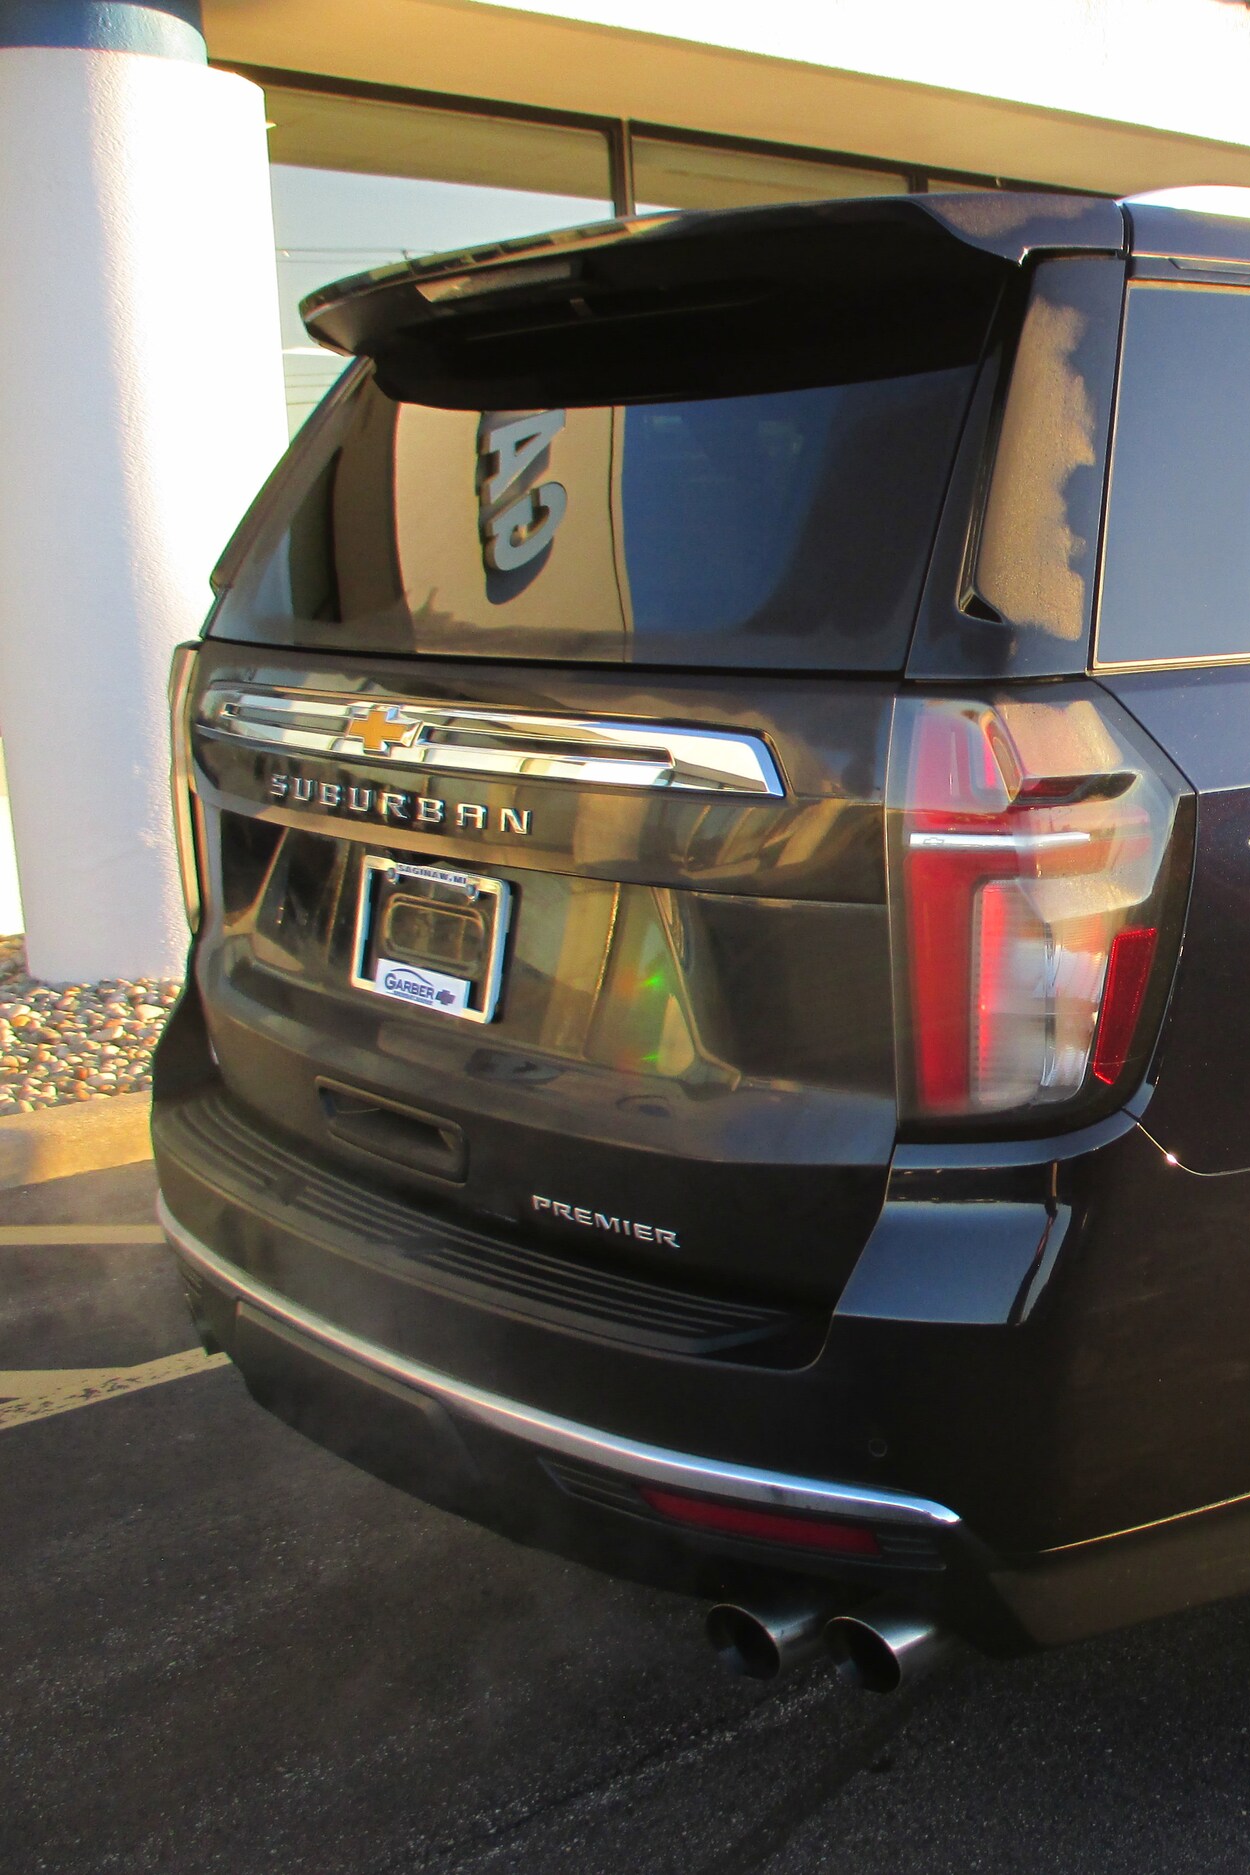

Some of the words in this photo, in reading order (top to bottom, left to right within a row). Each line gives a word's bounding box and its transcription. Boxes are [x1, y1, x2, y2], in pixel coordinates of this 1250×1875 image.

[269, 774, 532, 835] SUBURBAN
[384, 972, 435, 1000] GARBER
[532, 1194, 680, 1248] PREMIER
